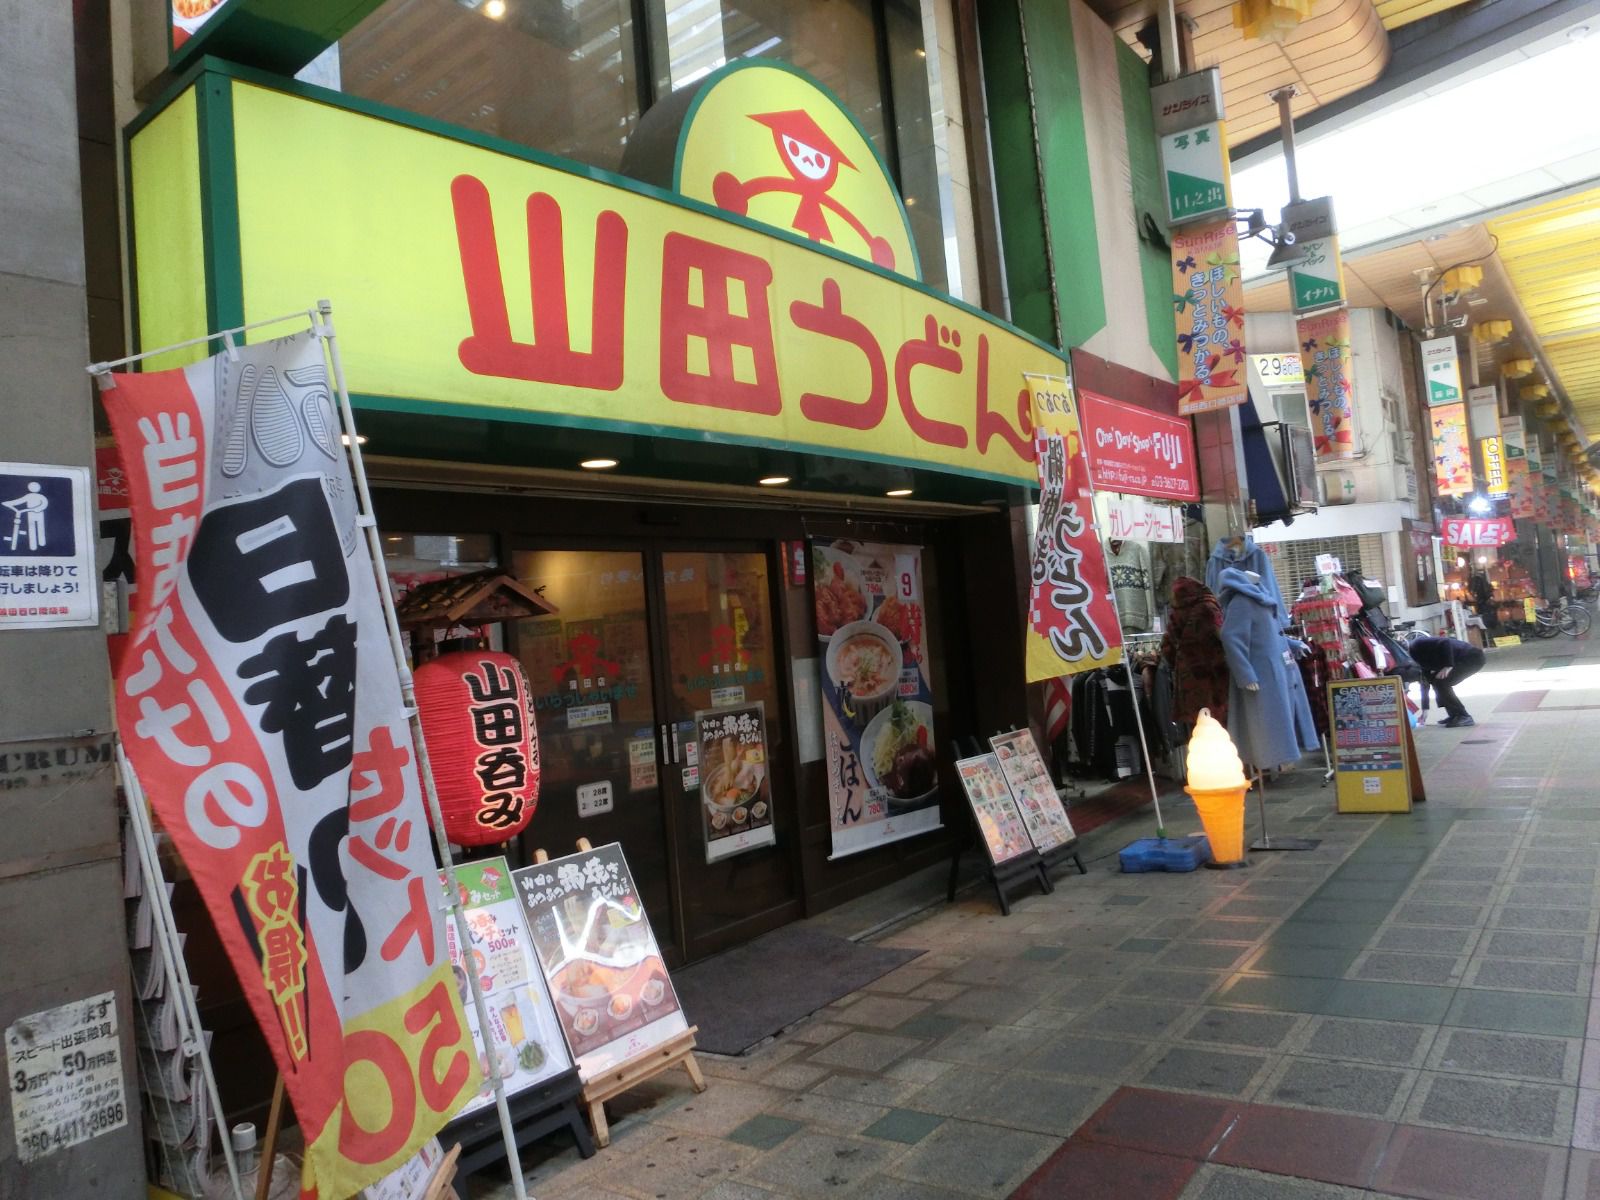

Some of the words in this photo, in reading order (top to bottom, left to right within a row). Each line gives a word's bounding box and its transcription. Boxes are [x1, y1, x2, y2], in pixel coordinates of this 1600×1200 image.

[451, 174, 1038, 462] 山田うどん
[1153, 432, 1183, 470] FUJI
[1109, 508, 1185, 541] ガレージセール
[462, 660, 527, 830] 山田呑み
